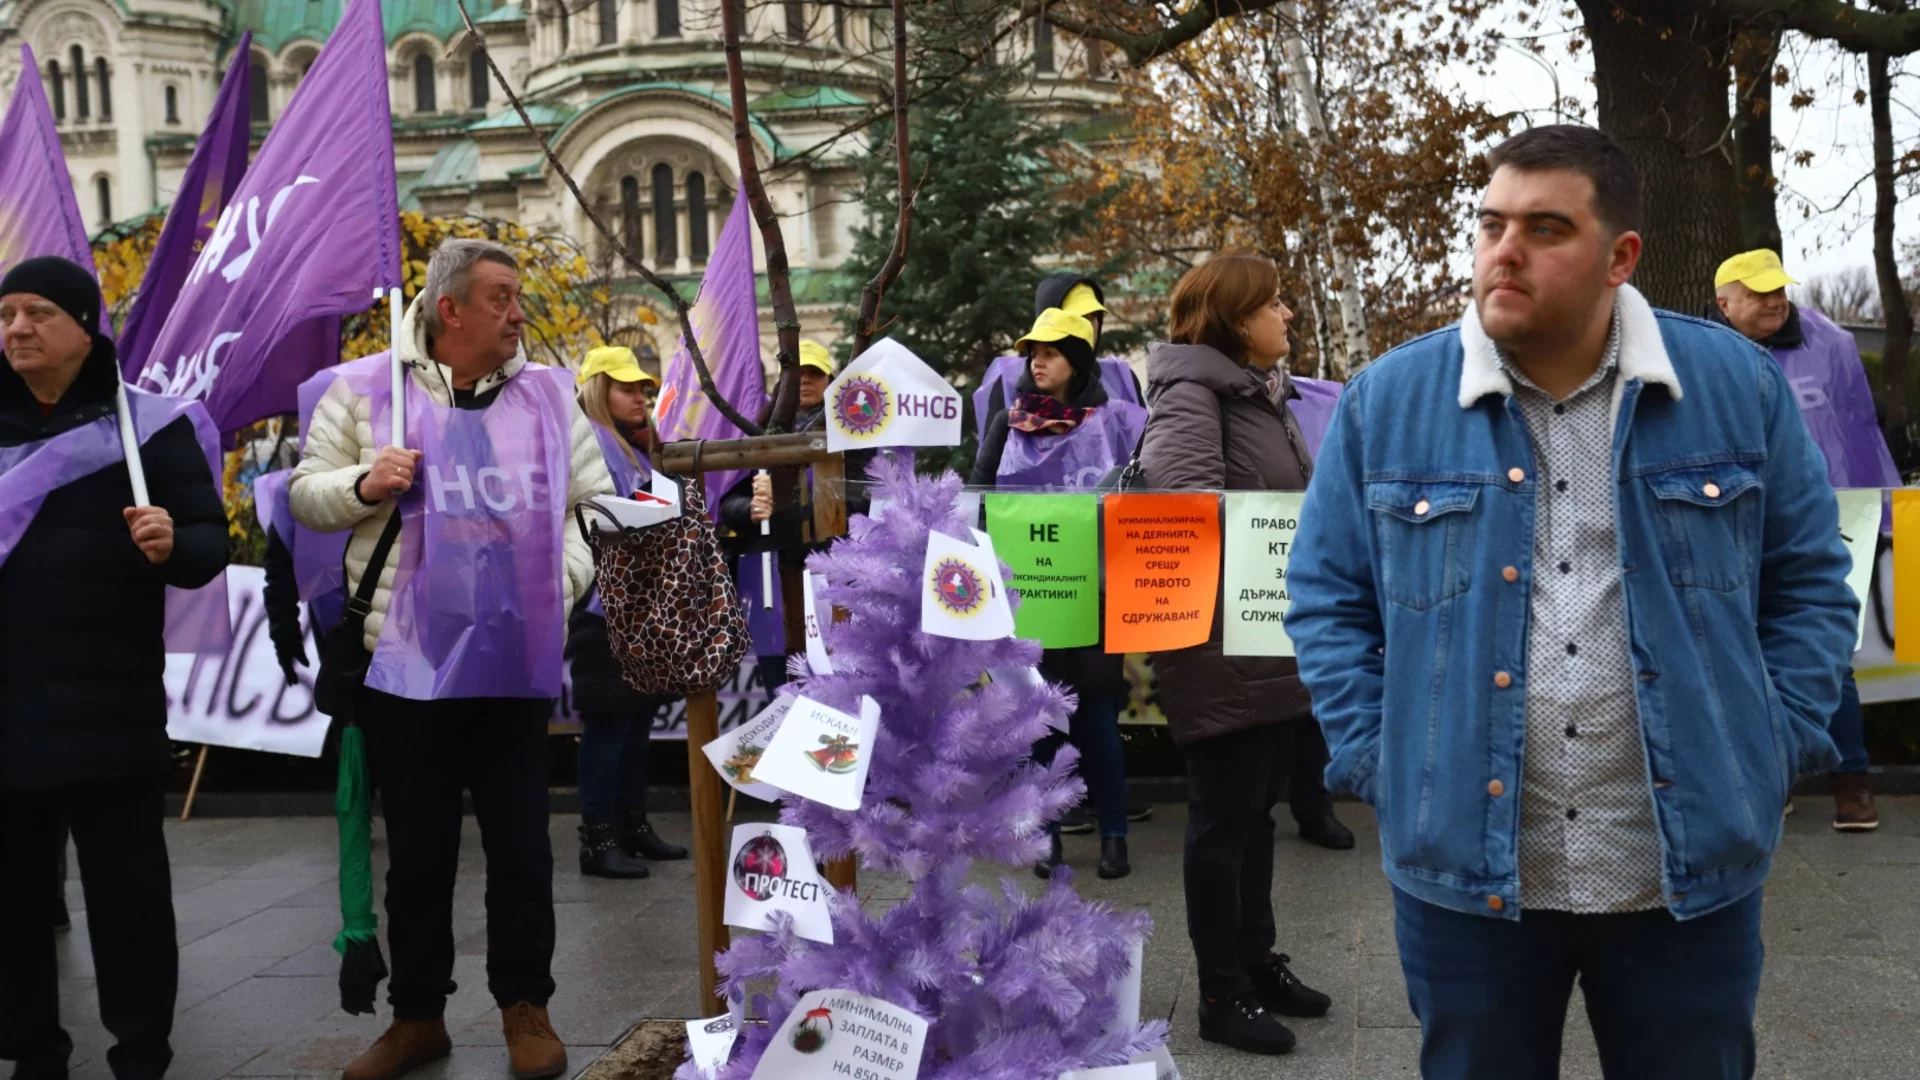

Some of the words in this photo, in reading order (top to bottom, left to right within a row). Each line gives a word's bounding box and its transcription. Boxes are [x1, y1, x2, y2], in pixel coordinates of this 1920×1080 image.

[897, 393, 958, 420] КНСБ
[425, 464, 550, 514] НСБ
[1118, 515, 1206, 526] КРИМИНАЛИЗИРАНЕ
[1251, 518, 1297, 530] ПРАВО
[1029, 523, 1060, 543] НЕ
[1126, 531, 1140, 540] НА
[1142, 529, 1199, 540] ДЕЯНИЯТА,
[1135, 545, 1190, 555] НАСОЧЕНИ
[1268, 542, 1292, 558] КТ
[1036, 557, 1053, 567] НА
[1145, 561, 1181, 571] СРЕЩУ
[1012, 573, 1088, 583] ТИСИНДИКАЛНИТЕ
[1134, 577, 1191, 589] ПРАВОТО
[1155, 597, 1170, 606] НА
[1121, 610, 1200, 624] СДРУЖАВАНЕ
[738, 713, 778, 746] ДОХОДИ
[774, 704, 791, 720] ЗА
[744, 873, 820, 902] ПРОТЕСТ
[828, 998, 913, 1037] МИНИМАЛНА
[839, 1020, 898, 1051] ЗАПЛАТА
[900, 1042, 909, 1055] В
[852, 1045, 904, 1072] РАЗМЕР
[832, 1060, 851, 1076] НА
[853, 1067, 879, 1080] 850
